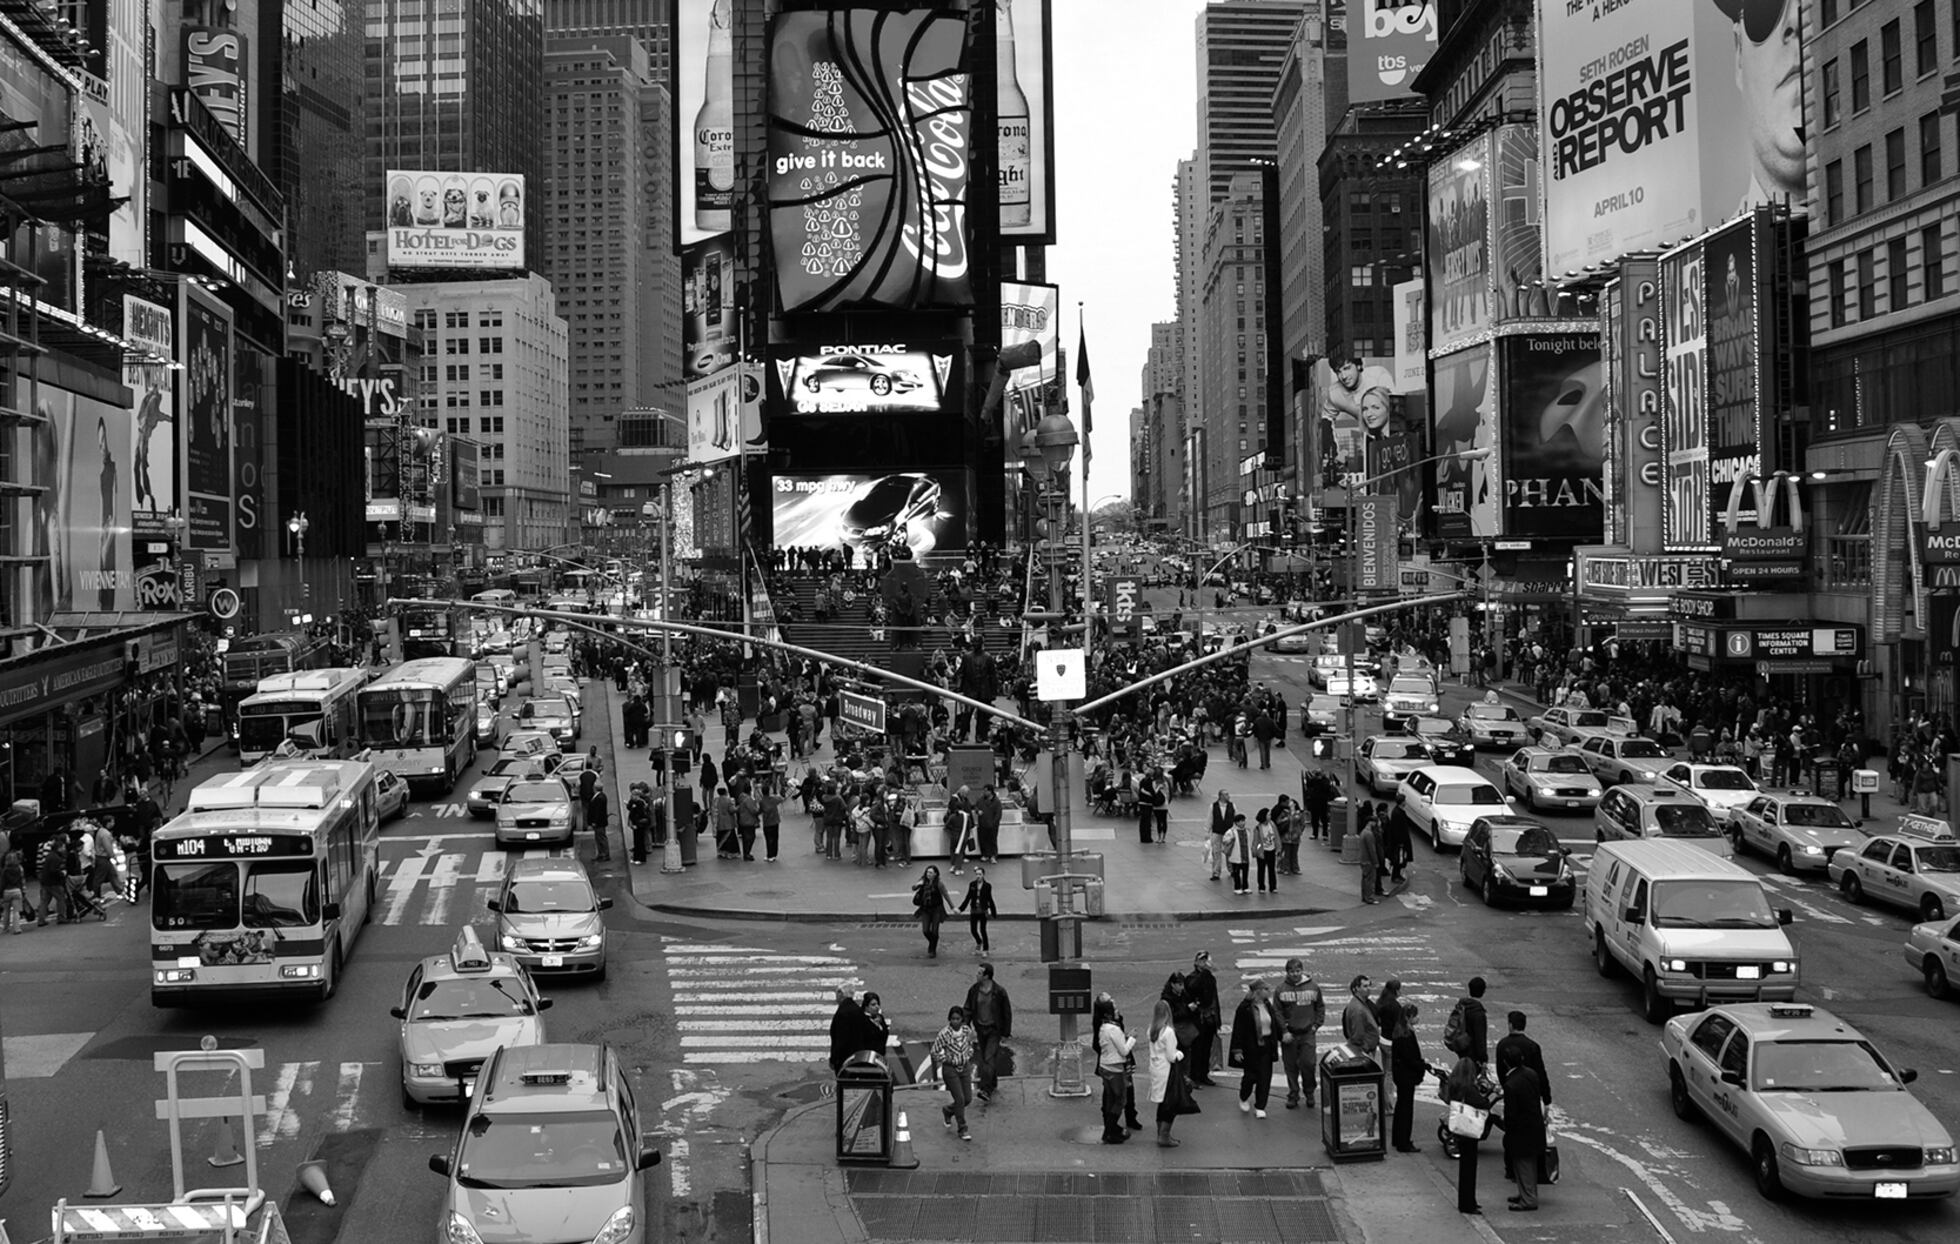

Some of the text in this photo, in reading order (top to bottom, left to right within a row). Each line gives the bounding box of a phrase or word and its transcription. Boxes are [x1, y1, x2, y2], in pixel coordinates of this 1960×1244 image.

[1566, 0, 1584, 17] THE
[1593, 6, 1600, 22] A
[1378, 55, 1406, 71] tbs
[1579, 33, 1650, 83] SETH ROGEN
[84, 76, 108, 100] PLAY
[1549, 38, 1691, 139] OBSERVE
[1558, 83, 1692, 181] REPORT
[776, 150, 886, 175] give it back
[900, 72, 970, 279] Coca-Cola
[1594, 186, 1645, 218] APRIL 10
[395, 229, 455, 249] HOTEL
[466, 232, 517, 251] DOGS
[820, 343, 907, 356] PONTIAC
[1528, 336, 1577, 354] Tonight
[1637, 281, 1660, 486] PALACE
[1711, 454, 1761, 485] CHICAGO
[777, 478, 793, 492] 33
[795, 480, 825, 496] mpg
[1362, 501, 1376, 587] BIENVENIDOS
[1727, 536, 1804, 548] McDonald's
[183, 563, 195, 602] KARIBU
[1638, 561, 1685, 586] WEST
[1732, 567, 1800, 575] OPEN 24 HOURS
[1115, 580, 1137, 622] tkts
[1680, 598, 1697, 614] BODY
[1757, 631, 1811, 640] TIMES SQUARE
[1758, 639, 1809, 648] INFORMATION
[1769, 647, 1798, 655] CENTER
[843, 700, 877, 724] Broadway
[176, 839, 205, 855] M104
